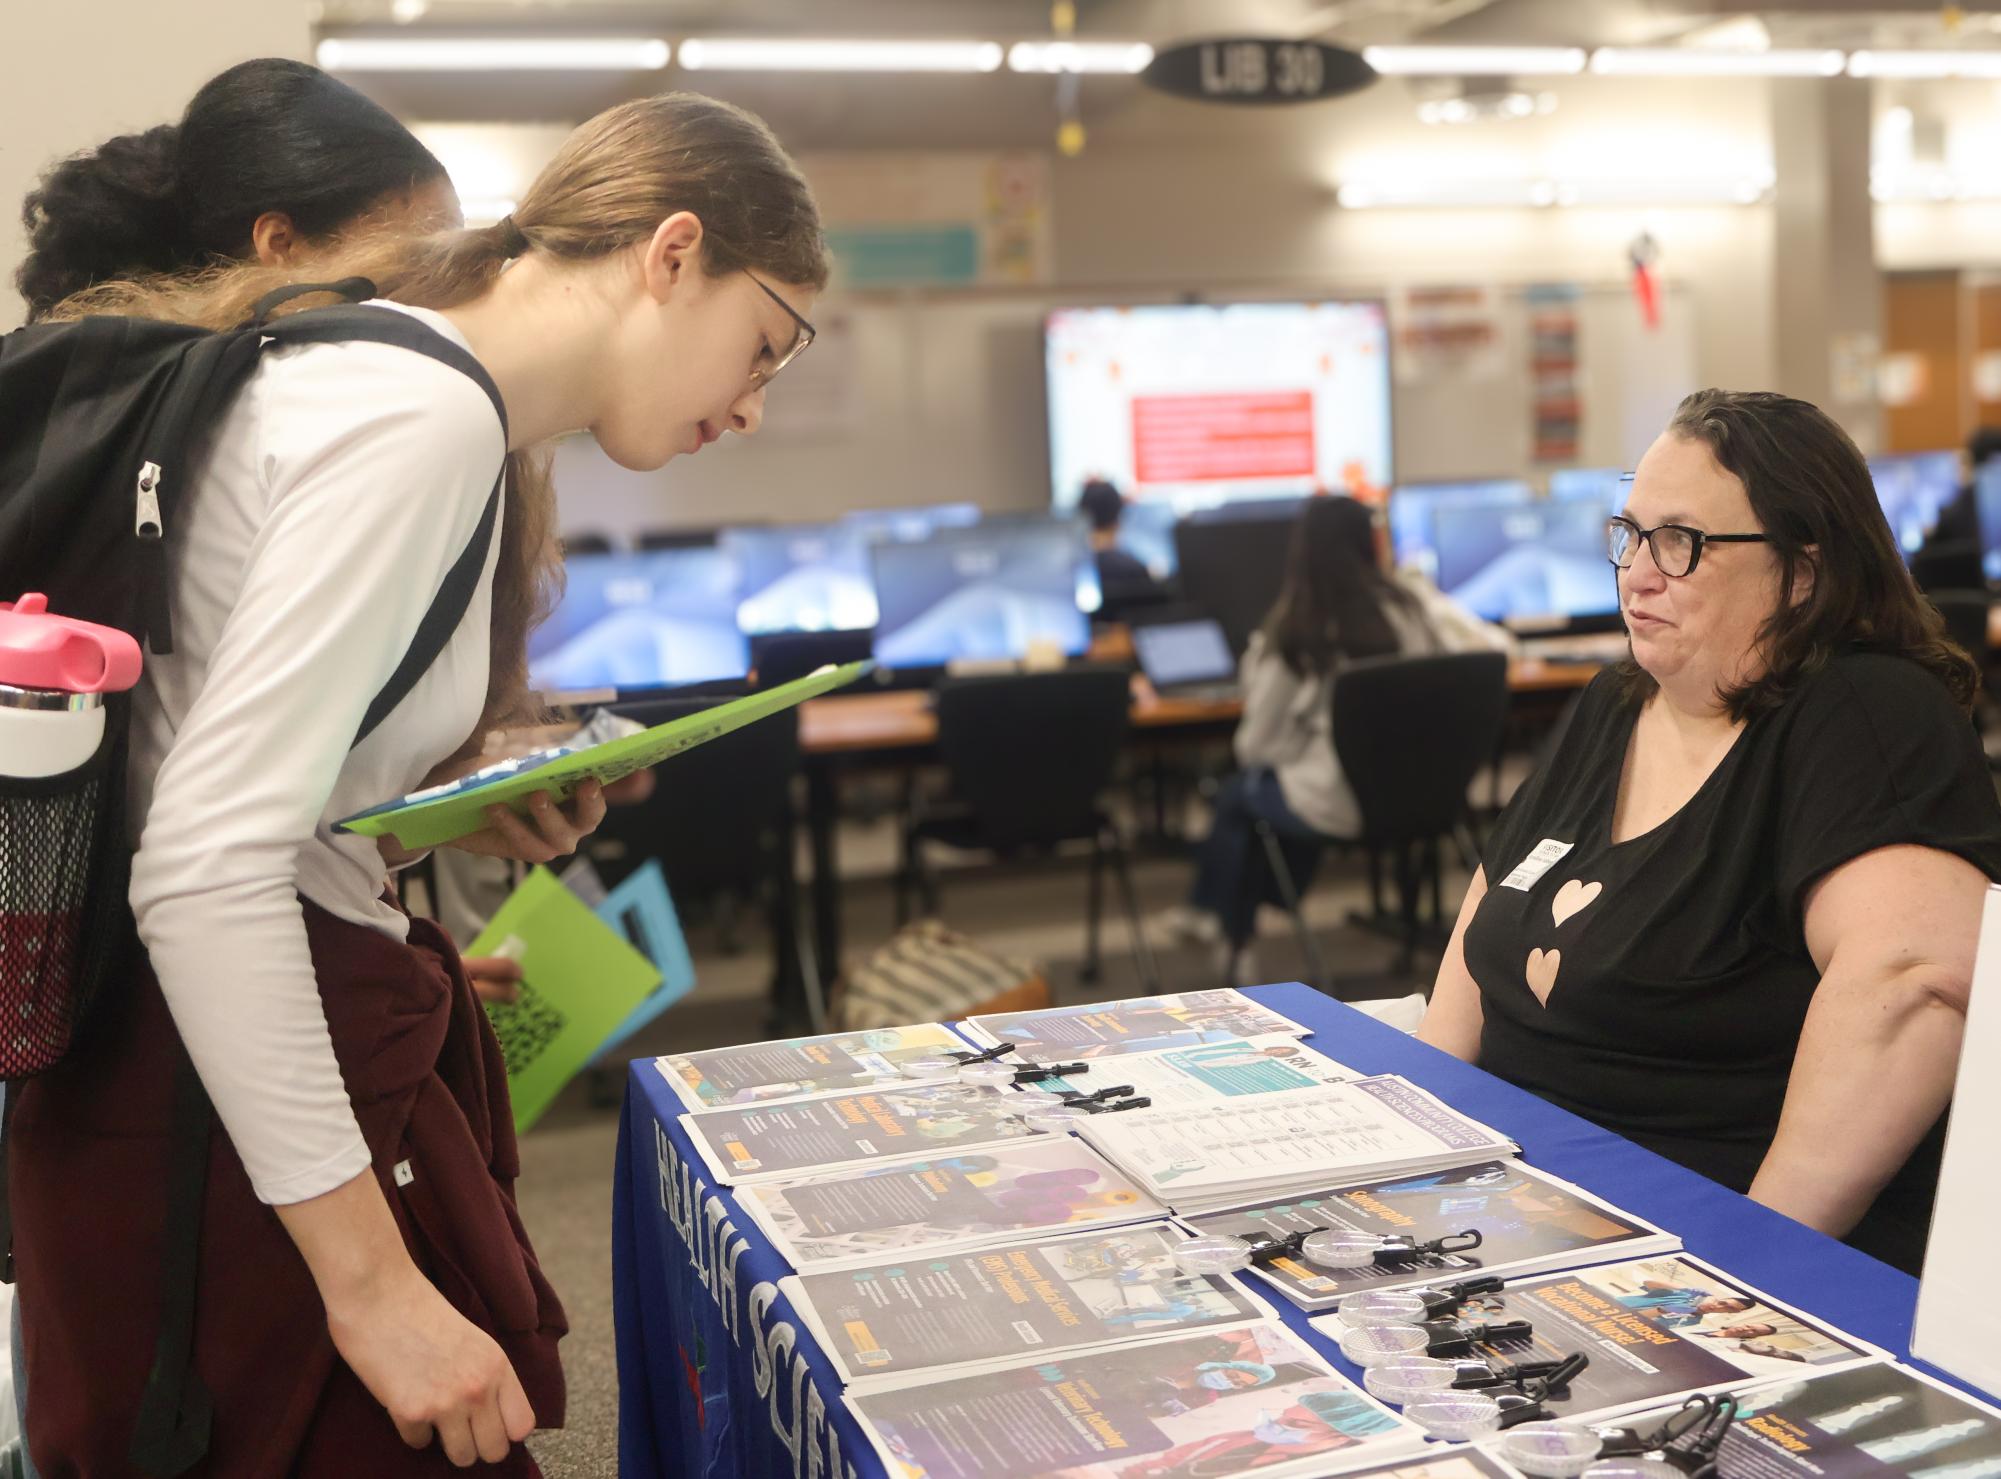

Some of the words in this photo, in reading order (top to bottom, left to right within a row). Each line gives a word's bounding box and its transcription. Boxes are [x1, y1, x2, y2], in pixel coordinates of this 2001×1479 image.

[1284, 1057, 1318, 1068] RN
[1344, 1191, 1416, 1226] Sonography
[653, 1117, 752, 1348] HEALTH
[1556, 1282, 1610, 1314] Become
[1604, 1309, 1620, 1317] a
[1534, 1286, 1602, 1323] Vocational
[1592, 1319, 1646, 1346] Nurse!
[1611, 1312, 1681, 1346] Licensed
[1745, 1416, 1812, 1452] Radiology
